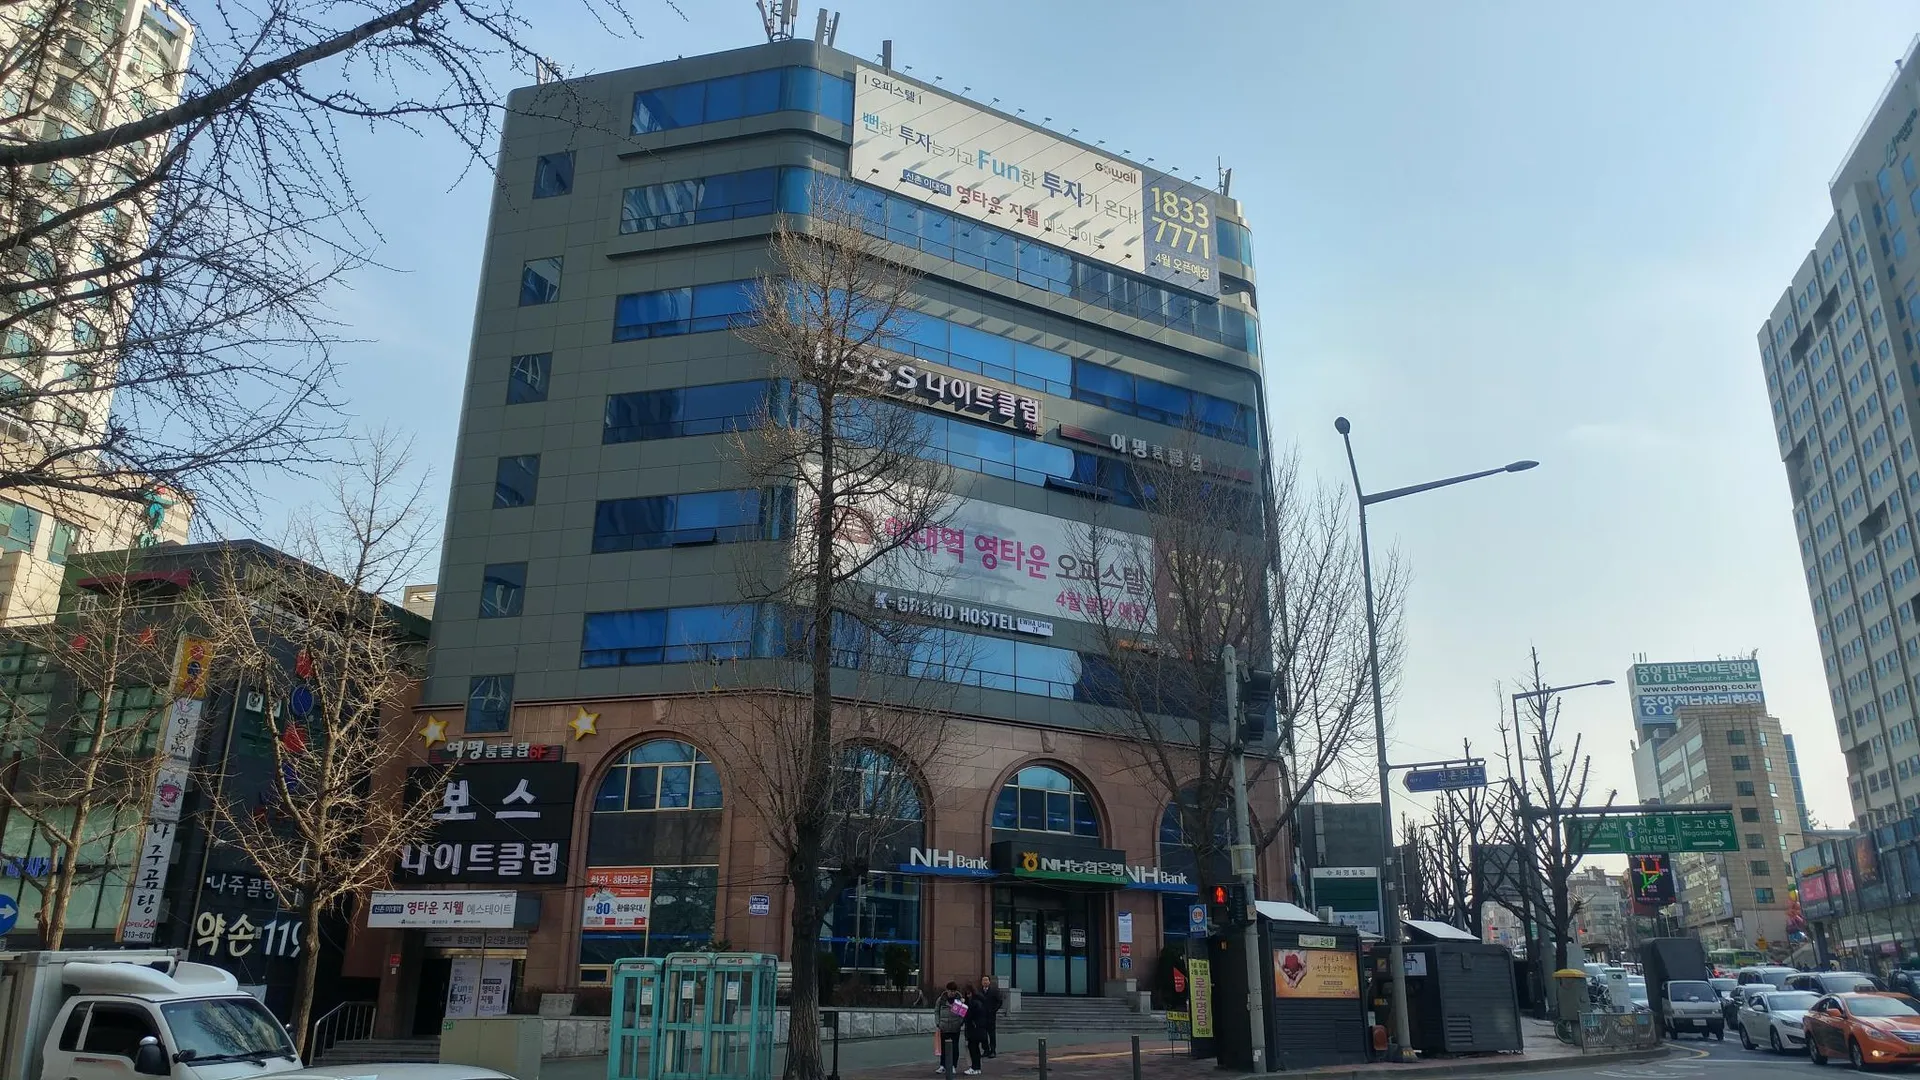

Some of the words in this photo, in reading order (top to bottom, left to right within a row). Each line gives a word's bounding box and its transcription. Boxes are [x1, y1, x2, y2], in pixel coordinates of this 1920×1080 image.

[871, 77, 915, 103] 오피스텔
[863, 112, 892, 138] 뻔한
[899, 125, 944, 157] 투자는
[978, 149, 1036, 189] Fun한
[1042, 171, 1099, 212] 투자가
[1104, 199, 1137, 225] 온다!
[957, 185, 1003, 215] 영타운
[1009, 202, 1039, 228] 지웰
[1151, 187, 1209, 229] 1833
[1152, 216, 1209, 259] 7771
[1155, 253, 1171, 268] 4월
[1174, 259, 1209, 280] 오픈예정
[926, 371, 1038, 423] 나이트클럽
[974, 535, 1050, 580] 영타운
[1055, 554, 1145, 597] 오피스텔
[1056, 590, 1081, 612] 4월
[960, 607, 1016, 631] HOSTEL
[1637, 662, 1756, 683] 중앙컴퓨터아트학원
[1642, 682, 1758, 693] www.choongang.co.kr
[530, 743, 548, 759] 6F
[432, 778, 541, 821] 보스
[1681, 818, 1729, 829] 노고산동
[1640, 834, 1677, 845] 이대입구
[401, 842, 560, 876] 나이트클럽
[910, 847, 953, 868] NH
[957, 855, 989, 870] Bank
[1041, 857, 1125, 877] NH농협은행
[211, 873, 275, 899] 나주곰탕
[1161, 871, 1188, 885] Bank
[407, 900, 438, 915] 영타운
[442, 900, 464, 915] 지웰
[466, 903, 512, 915] 에스테이트
[197, 911, 255, 957] 약손
